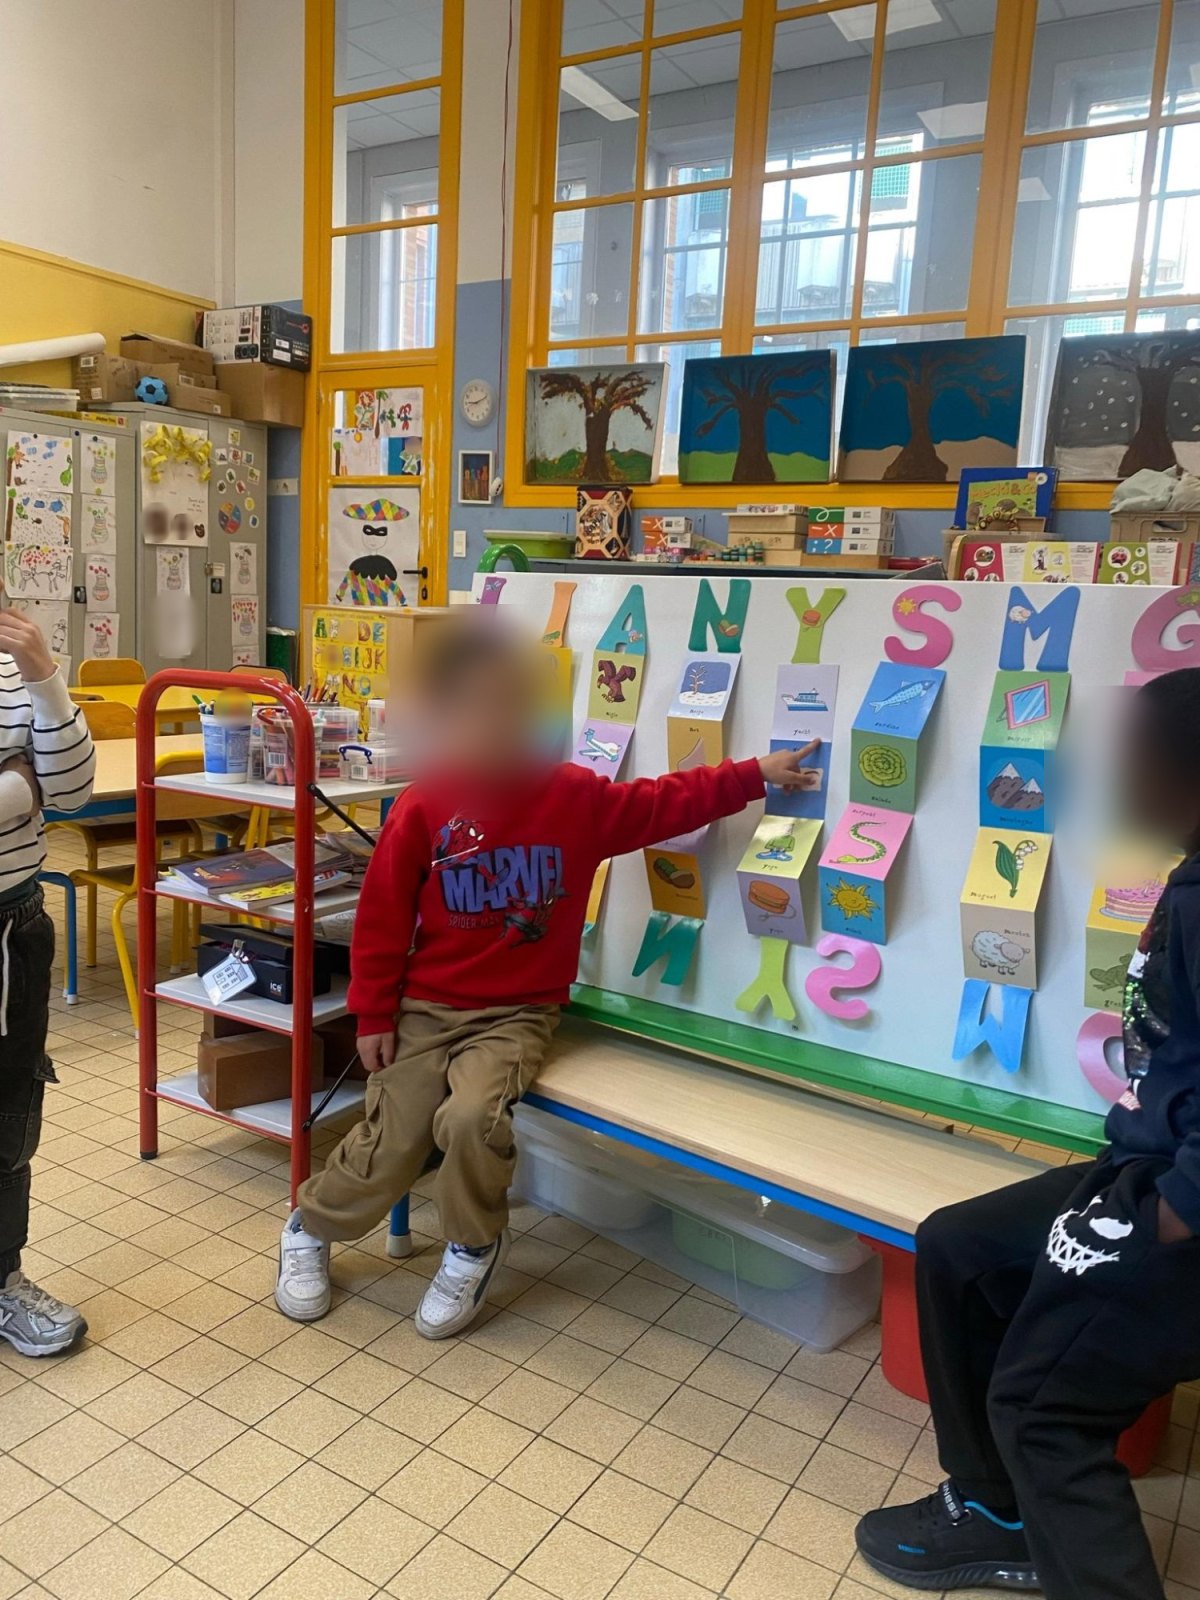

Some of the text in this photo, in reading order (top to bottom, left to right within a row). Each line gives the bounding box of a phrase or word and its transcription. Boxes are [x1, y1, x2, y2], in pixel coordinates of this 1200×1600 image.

[595, 584, 648, 655] A
[687, 578, 752, 653] N
[785, 586, 848, 664] Y
[884, 584, 962, 669] S
[999, 585, 1081, 673] M
[441, 844, 567, 914] MARVEL
